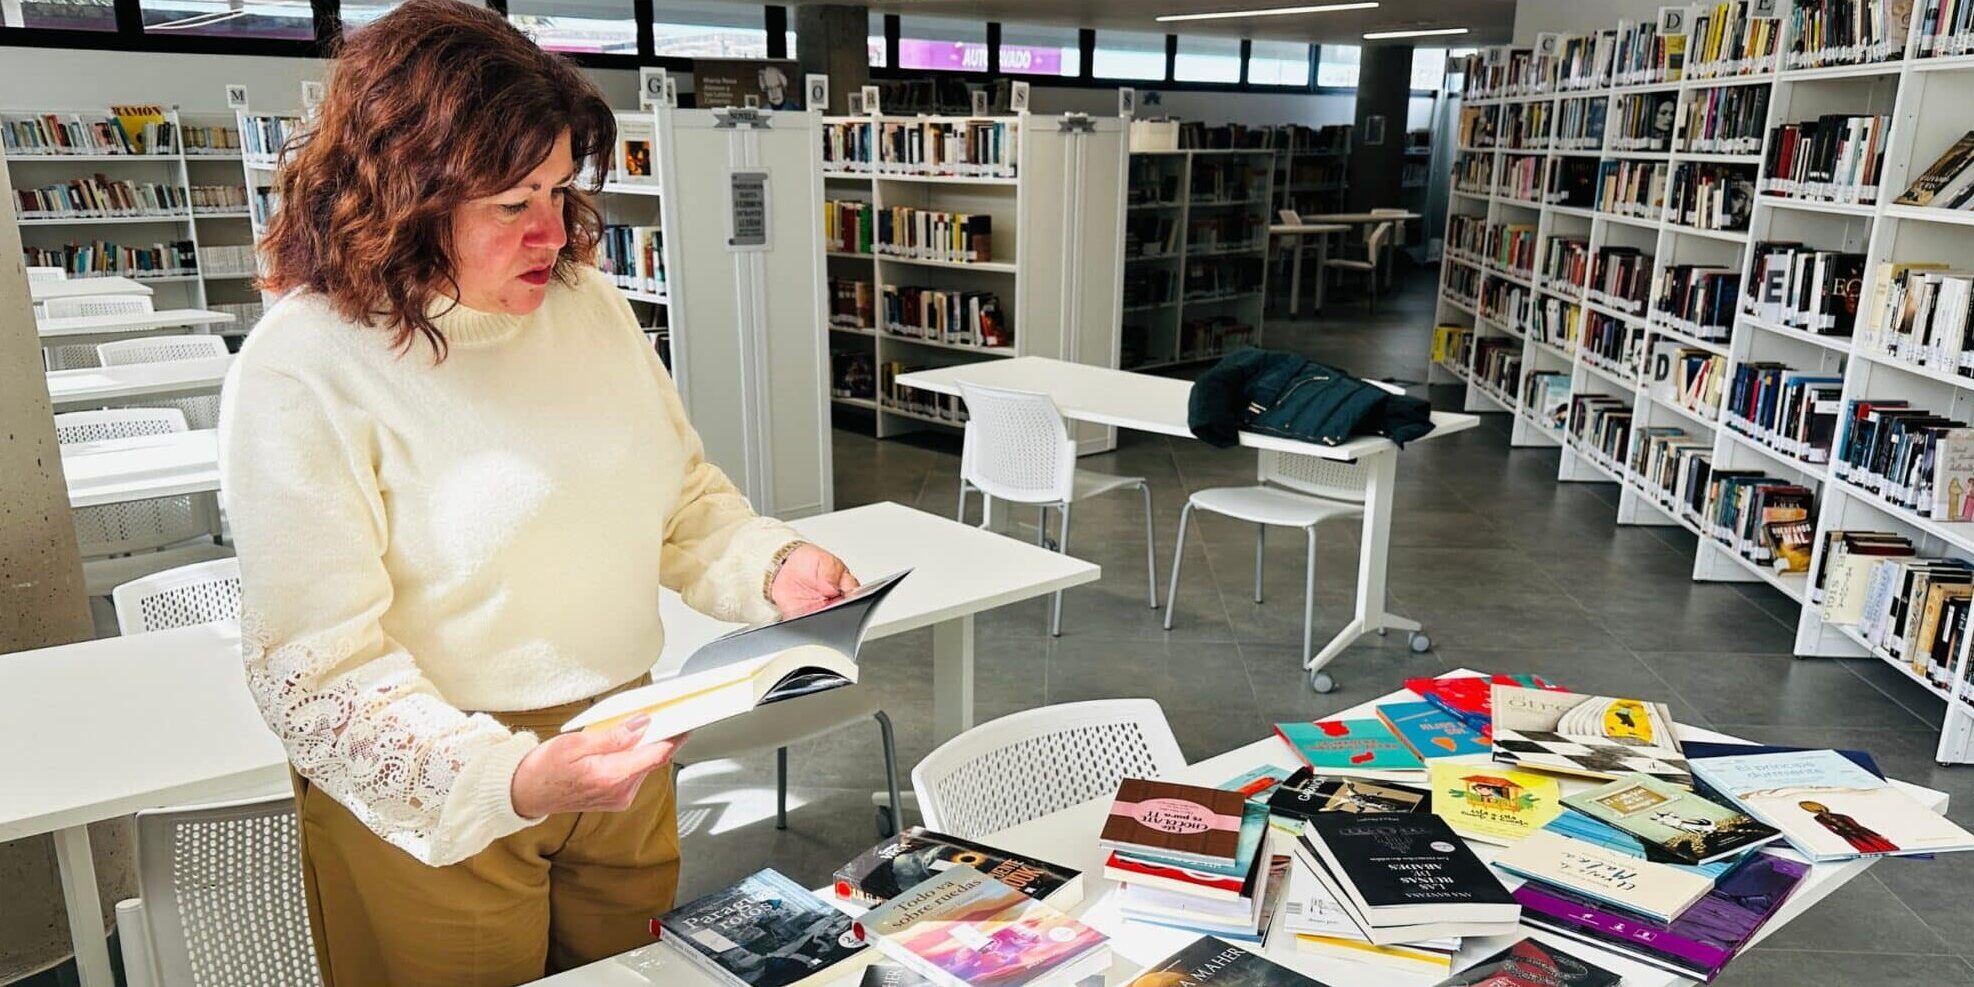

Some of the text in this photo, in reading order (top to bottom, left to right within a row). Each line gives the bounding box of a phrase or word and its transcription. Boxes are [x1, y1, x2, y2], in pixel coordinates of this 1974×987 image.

[1665, 12, 1681, 29] D
[1542, 37, 1554, 50] C
[648, 77, 662, 94] G
[811, 84, 824, 100] O
[230, 89, 245, 100] M
[111, 104, 162, 117] RAMÓN
[1765, 270, 1785, 303] E
[1655, 353, 1669, 381] D
[1141, 815, 1209, 831] CHOCOLATE
[1002, 864, 1045, 888] OOK
[1400, 876, 1455, 884] RUINAS
[1419, 883, 1446, 891] LAS
[891, 890, 936, 915] Todo
[936, 879, 955, 895] va
[892, 903, 936, 929] sobre
[935, 878, 983, 908] ruedas
[718, 902, 774, 930] rotos
[1190, 947, 1246, 982] MAHER
